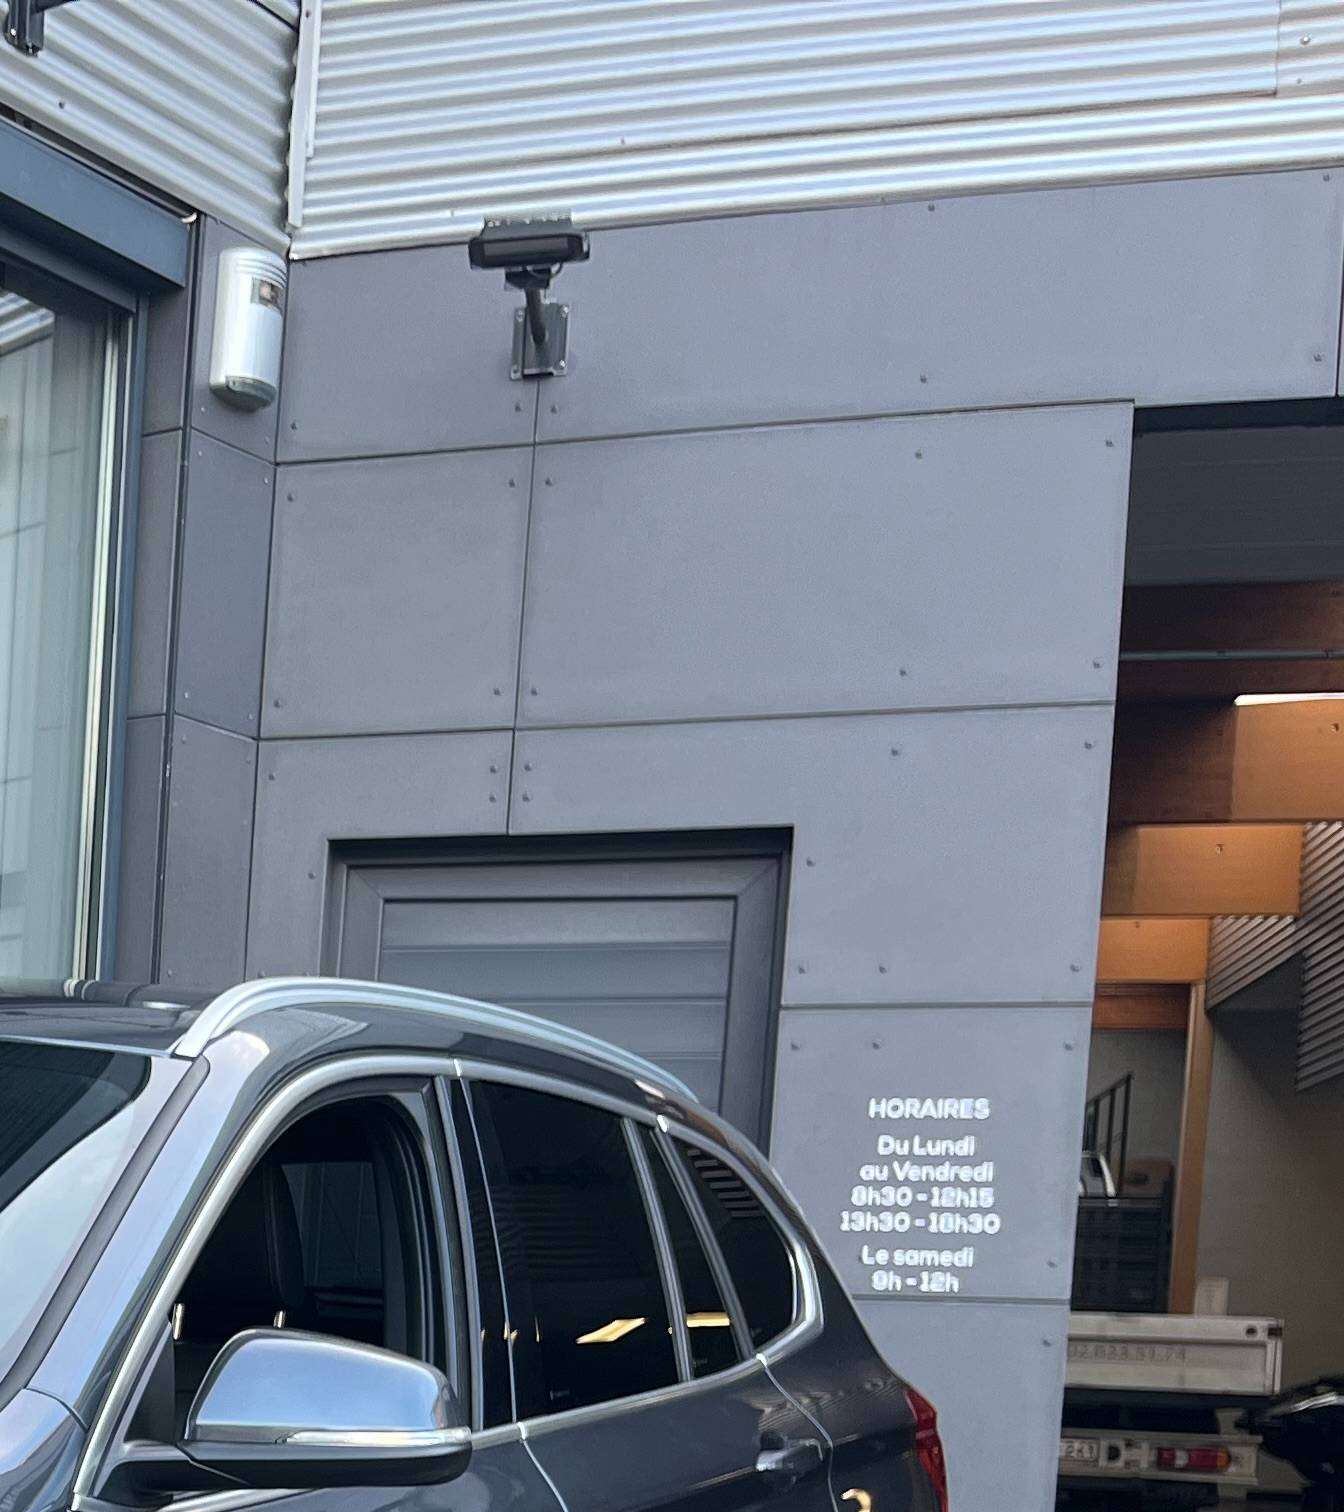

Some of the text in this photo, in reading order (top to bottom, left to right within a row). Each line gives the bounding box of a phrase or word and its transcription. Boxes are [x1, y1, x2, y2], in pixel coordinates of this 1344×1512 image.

[868, 1097, 991, 1120] HORAIRES
[877, 1134, 975, 1157] Du Lundi
[859, 1160, 995, 1183] au Vendredi
[916, 1192, 929, 1202] -
[930, 1186, 995, 1208] 12h15
[839, 1210, 1001, 1235] 13h30 - 18h30
[861, 1244, 975, 1268] Le samedi
[905, 1277, 918, 1287] -
[919, 1271, 960, 1293] 12h
